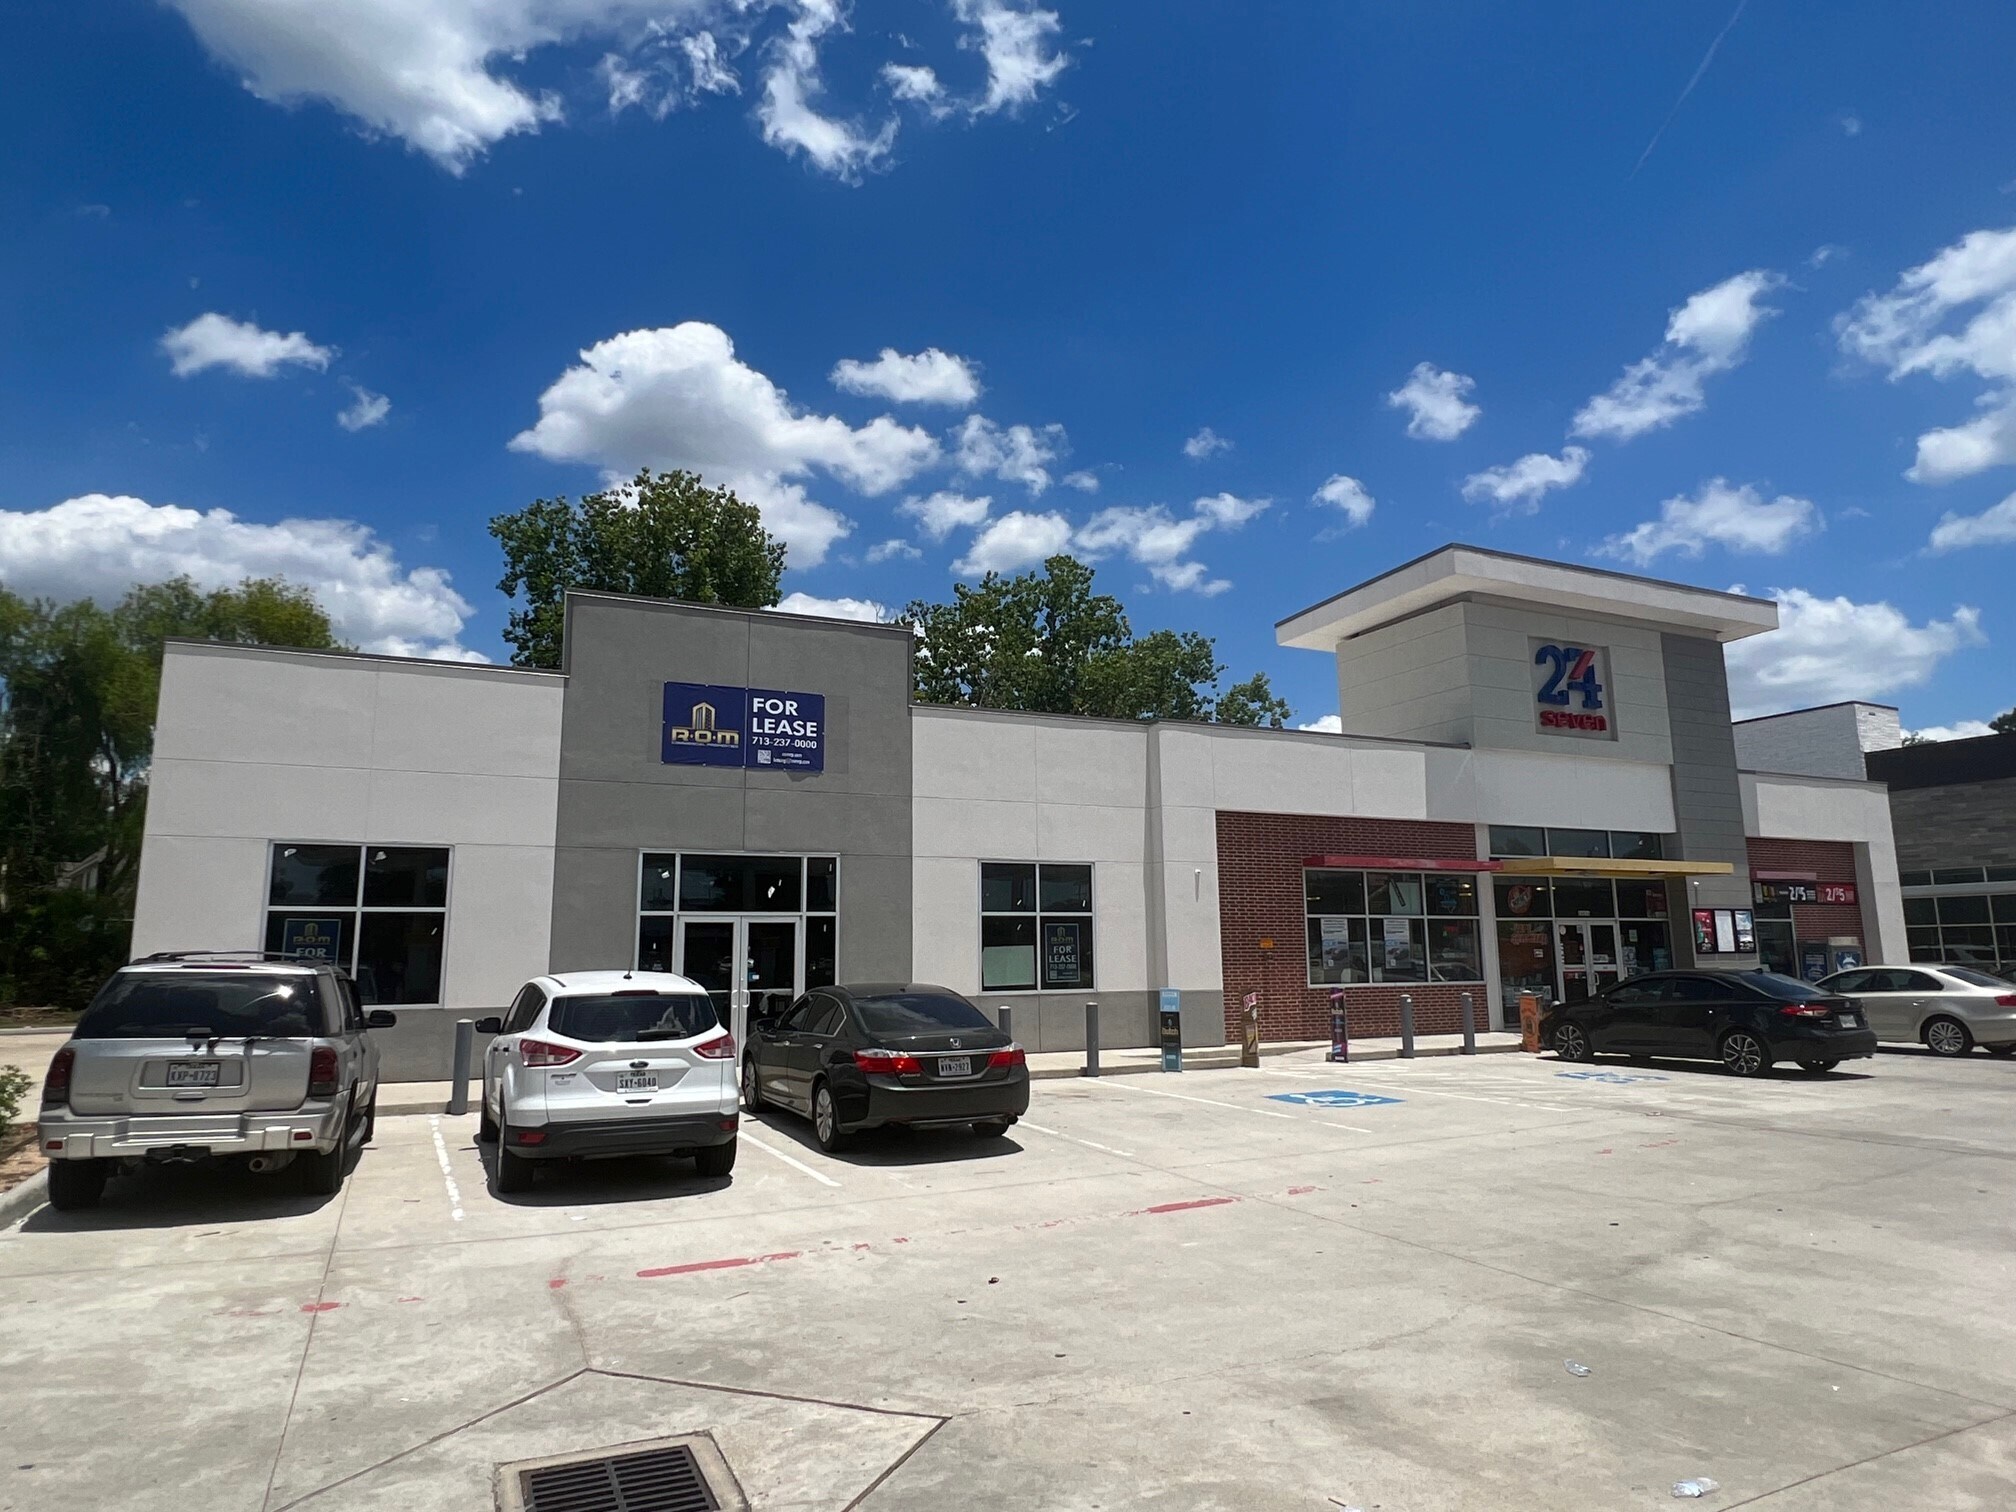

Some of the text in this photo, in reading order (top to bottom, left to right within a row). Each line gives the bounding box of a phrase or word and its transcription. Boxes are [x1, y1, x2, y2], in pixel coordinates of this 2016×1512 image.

[753, 697, 799, 716] FOR
[752, 717, 817, 737] LEASE
[752, 736, 817, 749] 713-237-0000
[296, 947, 327, 957] FOR
[1053, 945, 1072, 954] FOR
[1048, 954, 1077, 963] LEASE
